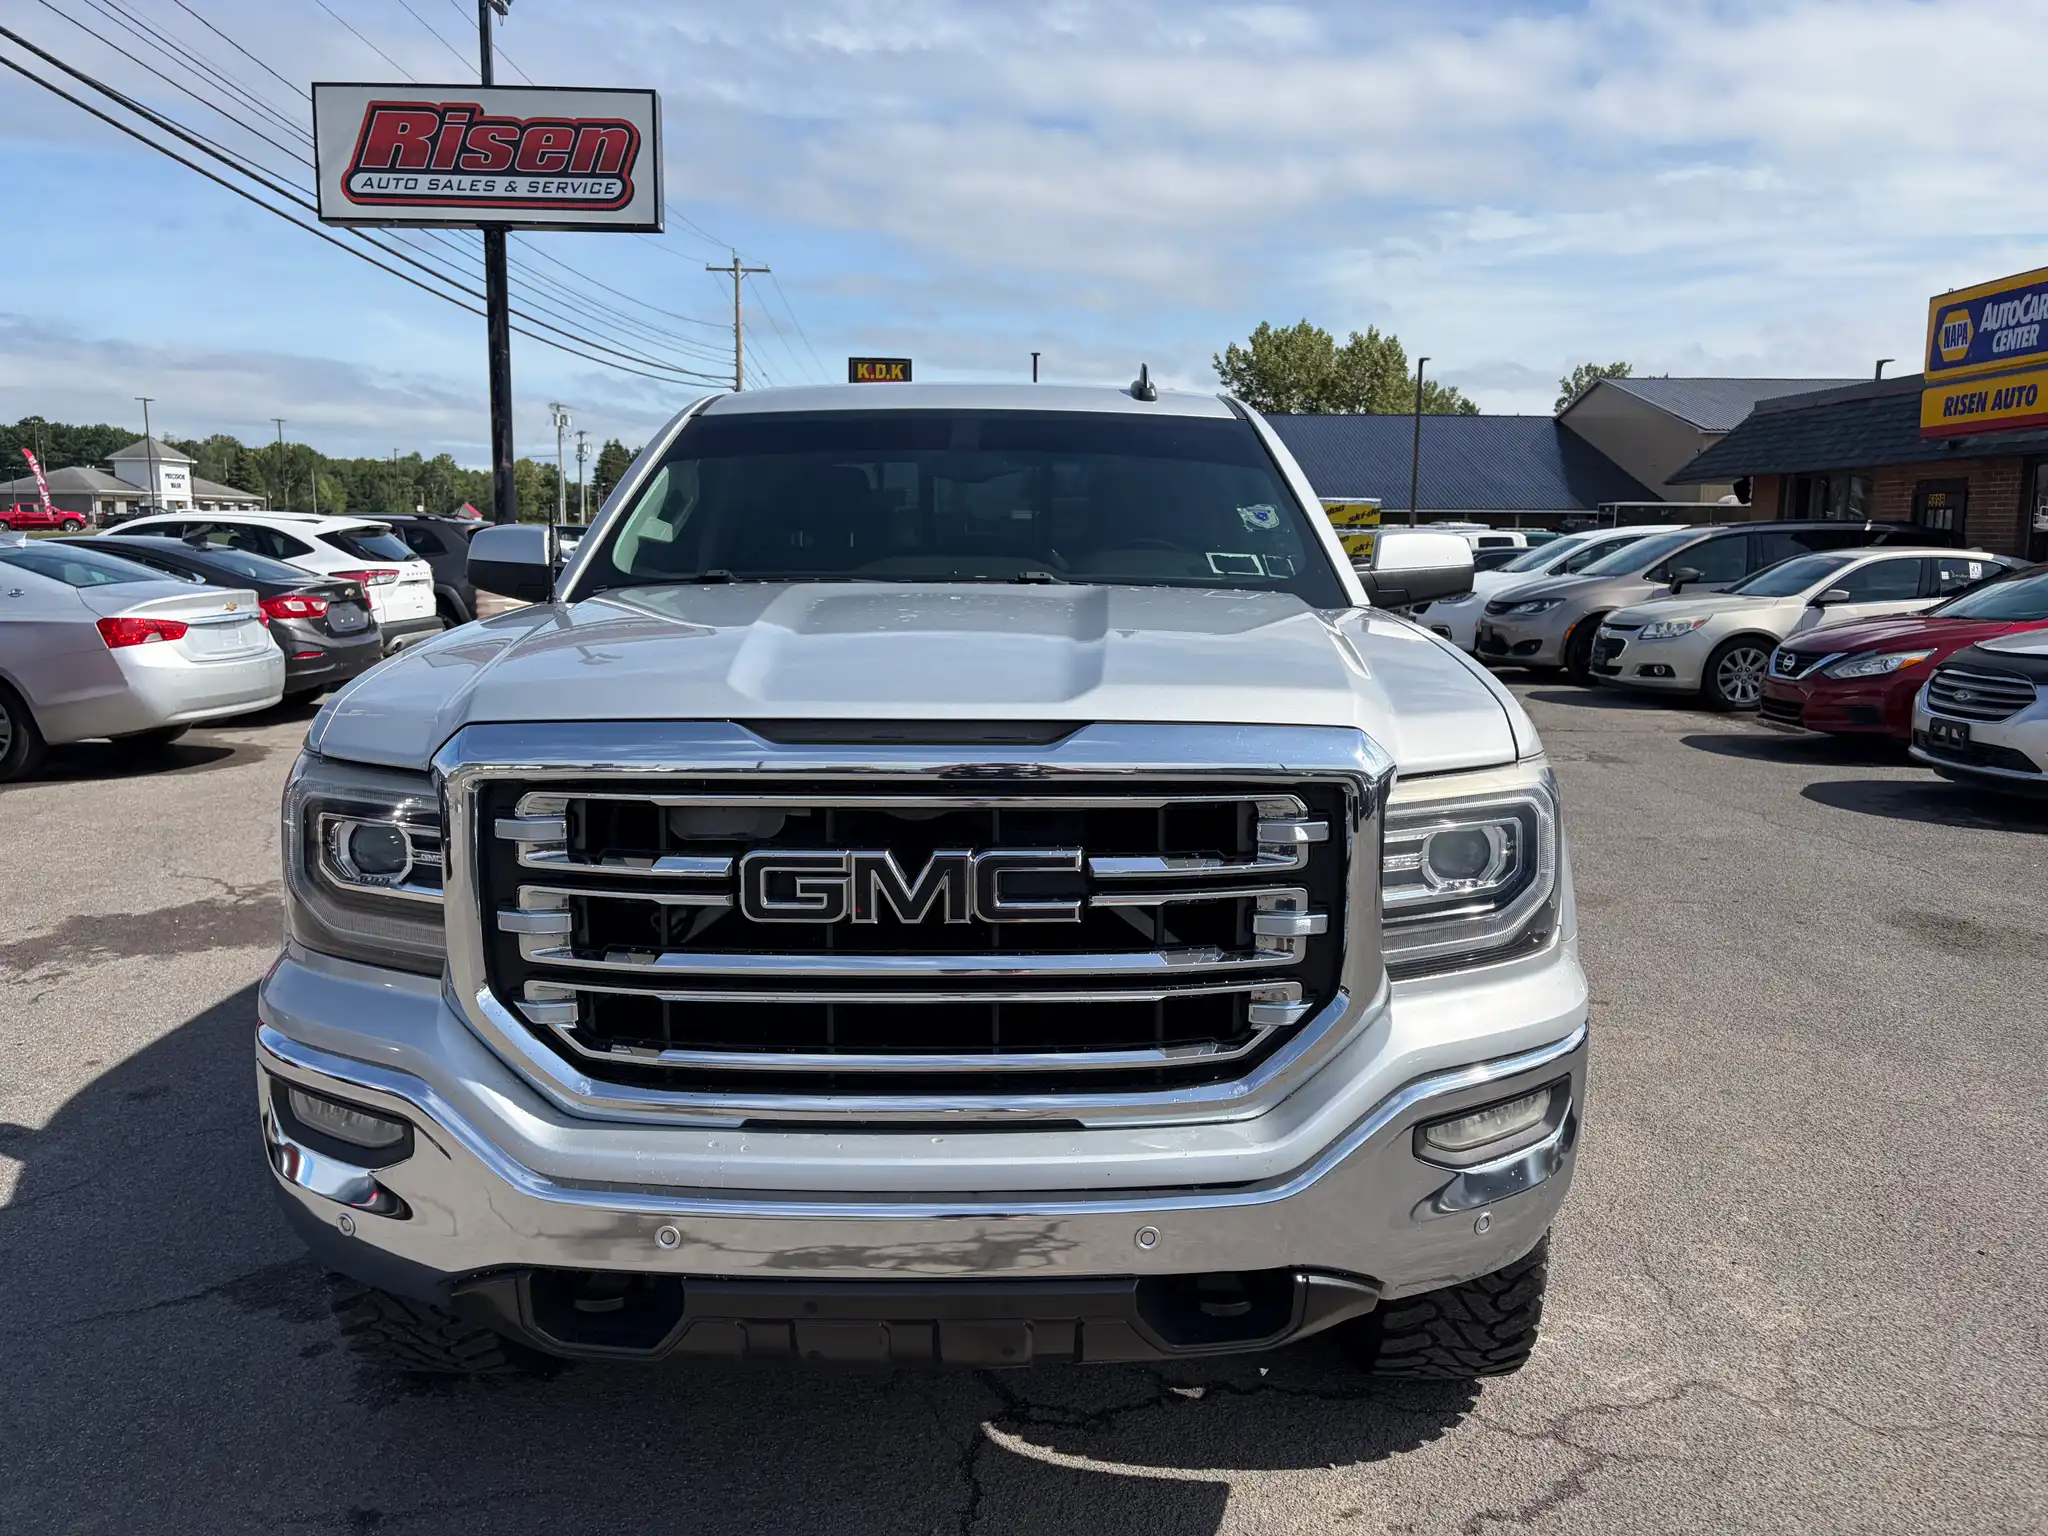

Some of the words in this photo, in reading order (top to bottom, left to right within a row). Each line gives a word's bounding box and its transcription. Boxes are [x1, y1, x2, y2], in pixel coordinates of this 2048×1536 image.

[359, 109, 629, 174] Risen
[361, 176, 418, 191] AUTO
[427, 178, 496, 193] SALES
[504, 180, 519, 194] &
[527, 181, 617, 196] SERVICE
[1943, 321, 1968, 349] NAPA
[1992, 323, 2040, 353] CENTER
[1943, 390, 1989, 418] RISEN
[1990, 384, 2038, 411] AUTO
[740, 849, 1083, 925] GMC
